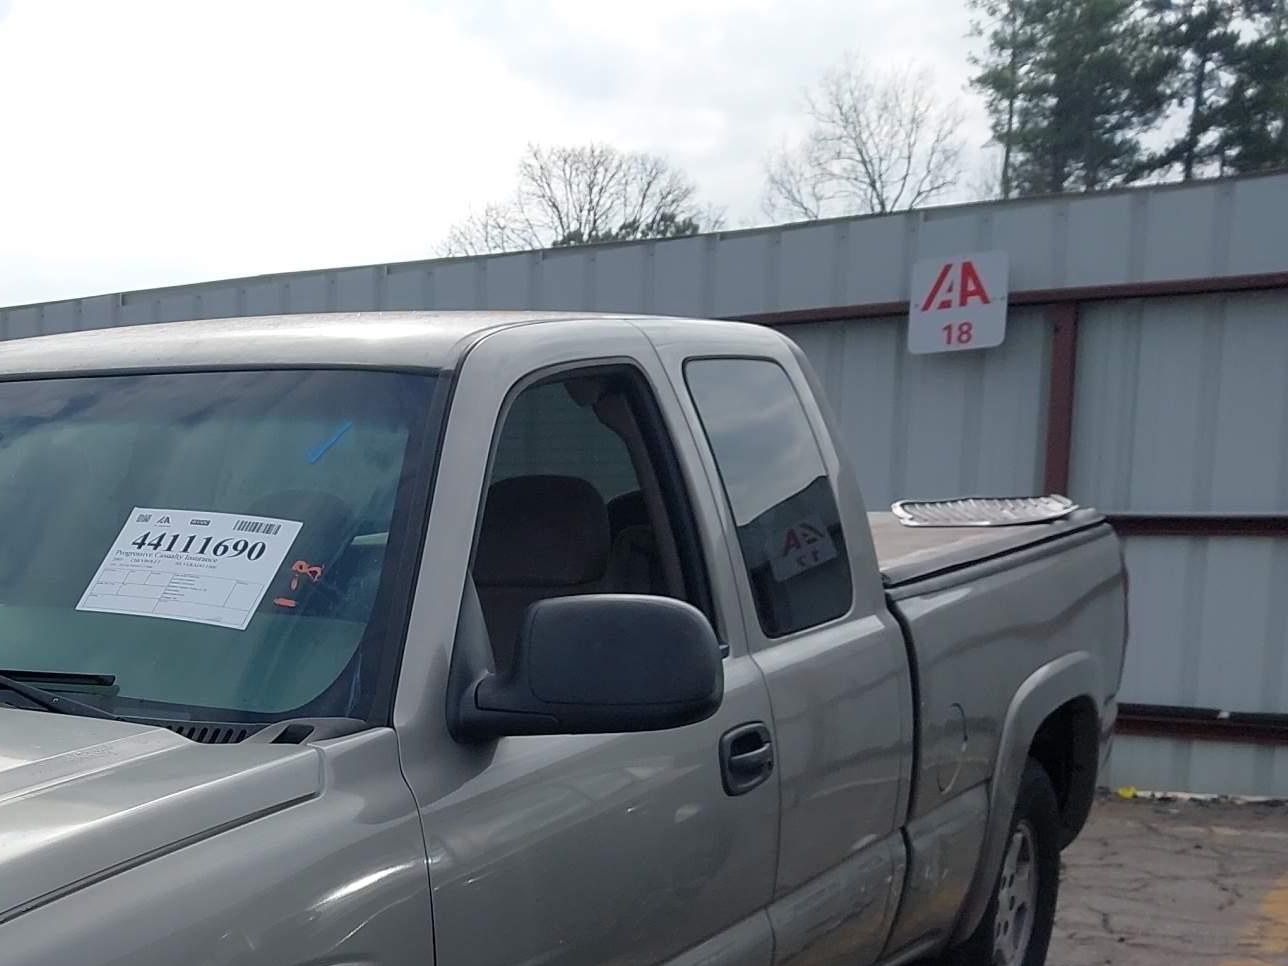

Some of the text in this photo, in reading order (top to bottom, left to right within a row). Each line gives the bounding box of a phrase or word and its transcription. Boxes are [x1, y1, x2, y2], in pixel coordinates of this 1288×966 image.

[942, 321, 973, 345] 18
[131, 531, 267, 562] 44111690
[154, 551, 183, 561] Casualty
[184, 553, 219, 563] Insurance
